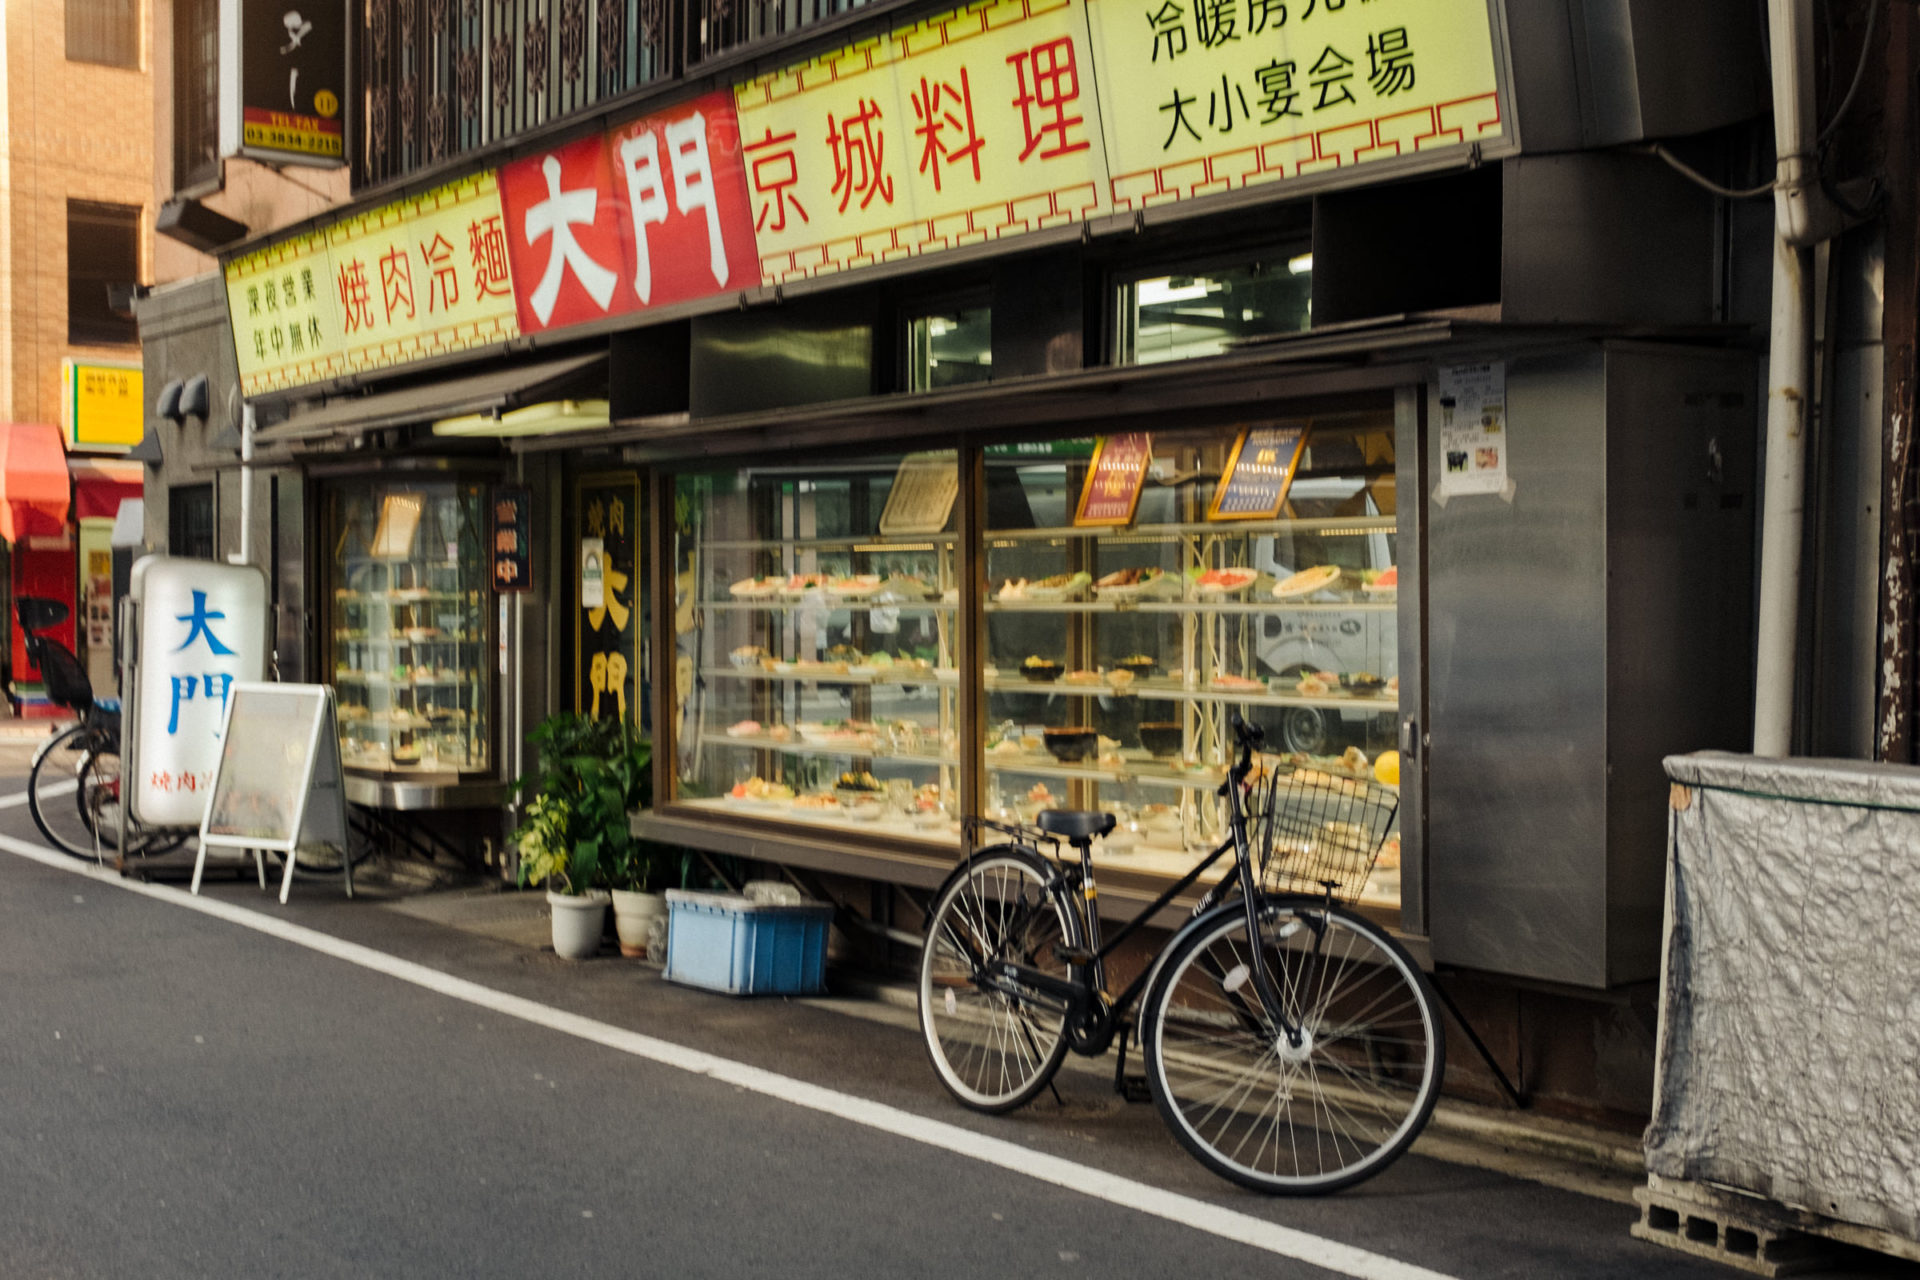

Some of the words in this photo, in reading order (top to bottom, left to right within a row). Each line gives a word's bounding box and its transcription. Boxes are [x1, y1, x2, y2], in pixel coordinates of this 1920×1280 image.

[743, 36, 1091, 233] 京城料理
[1159, 26, 1416, 150] 大小宴会場
[524, 110, 730, 328] 大門
[247, 266, 316, 317] 深夜営業
[253, 314, 323, 362] 年中無休
[167, 589, 239, 740] 大門
